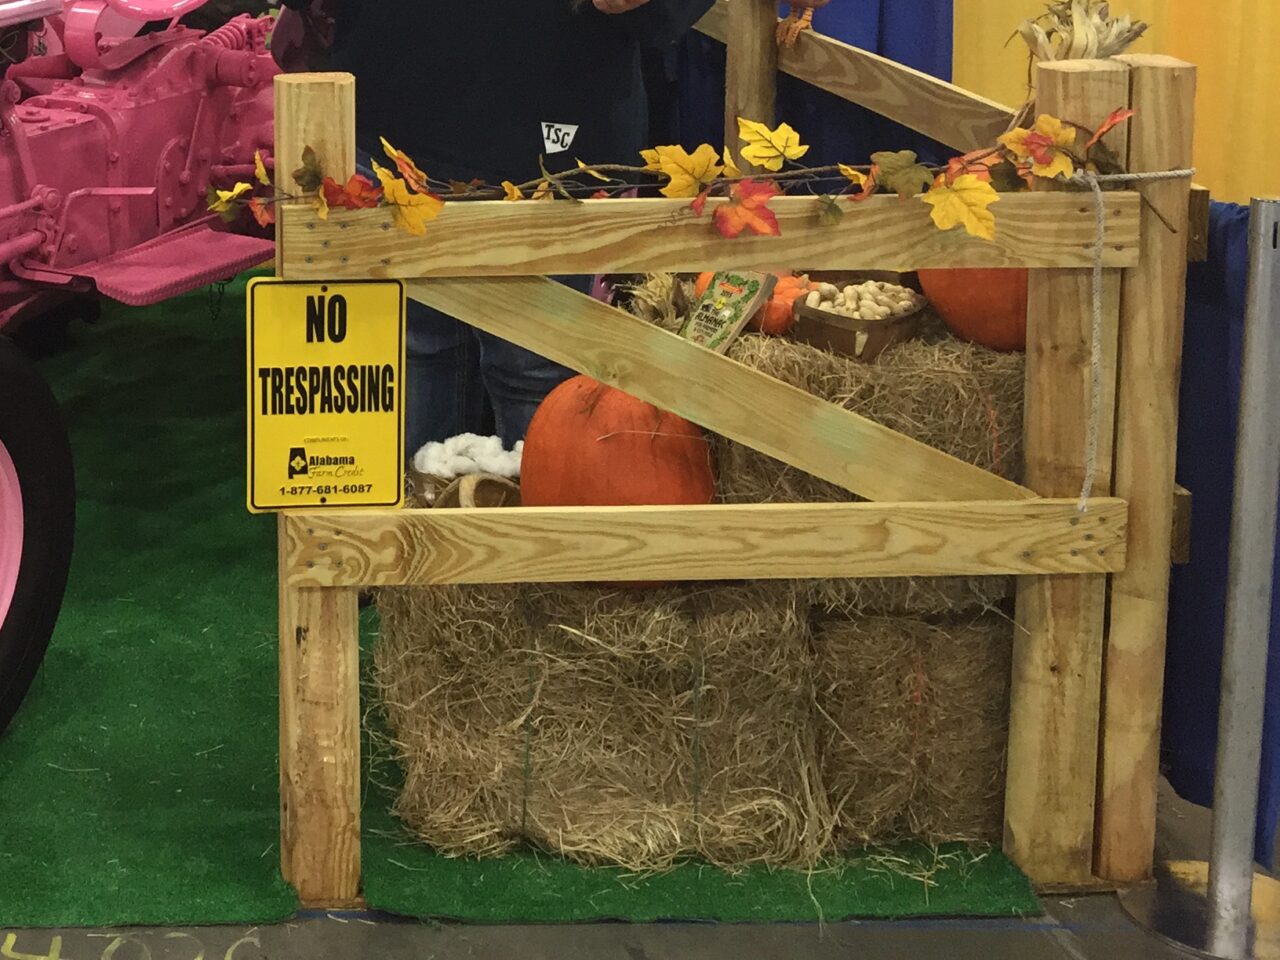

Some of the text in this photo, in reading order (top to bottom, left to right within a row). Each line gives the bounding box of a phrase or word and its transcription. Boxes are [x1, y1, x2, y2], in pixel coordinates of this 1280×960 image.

[545, 124, 570, 149] TSC
[306, 294, 347, 343] NO
[695, 311, 727, 328] ALMANAC
[258, 363, 394, 416] TRESPASSING
[309, 455, 355, 466] Alabama
[308, 465, 364, 479] Farm Credit
[279, 484, 373, 496] 1-877-681-6087
